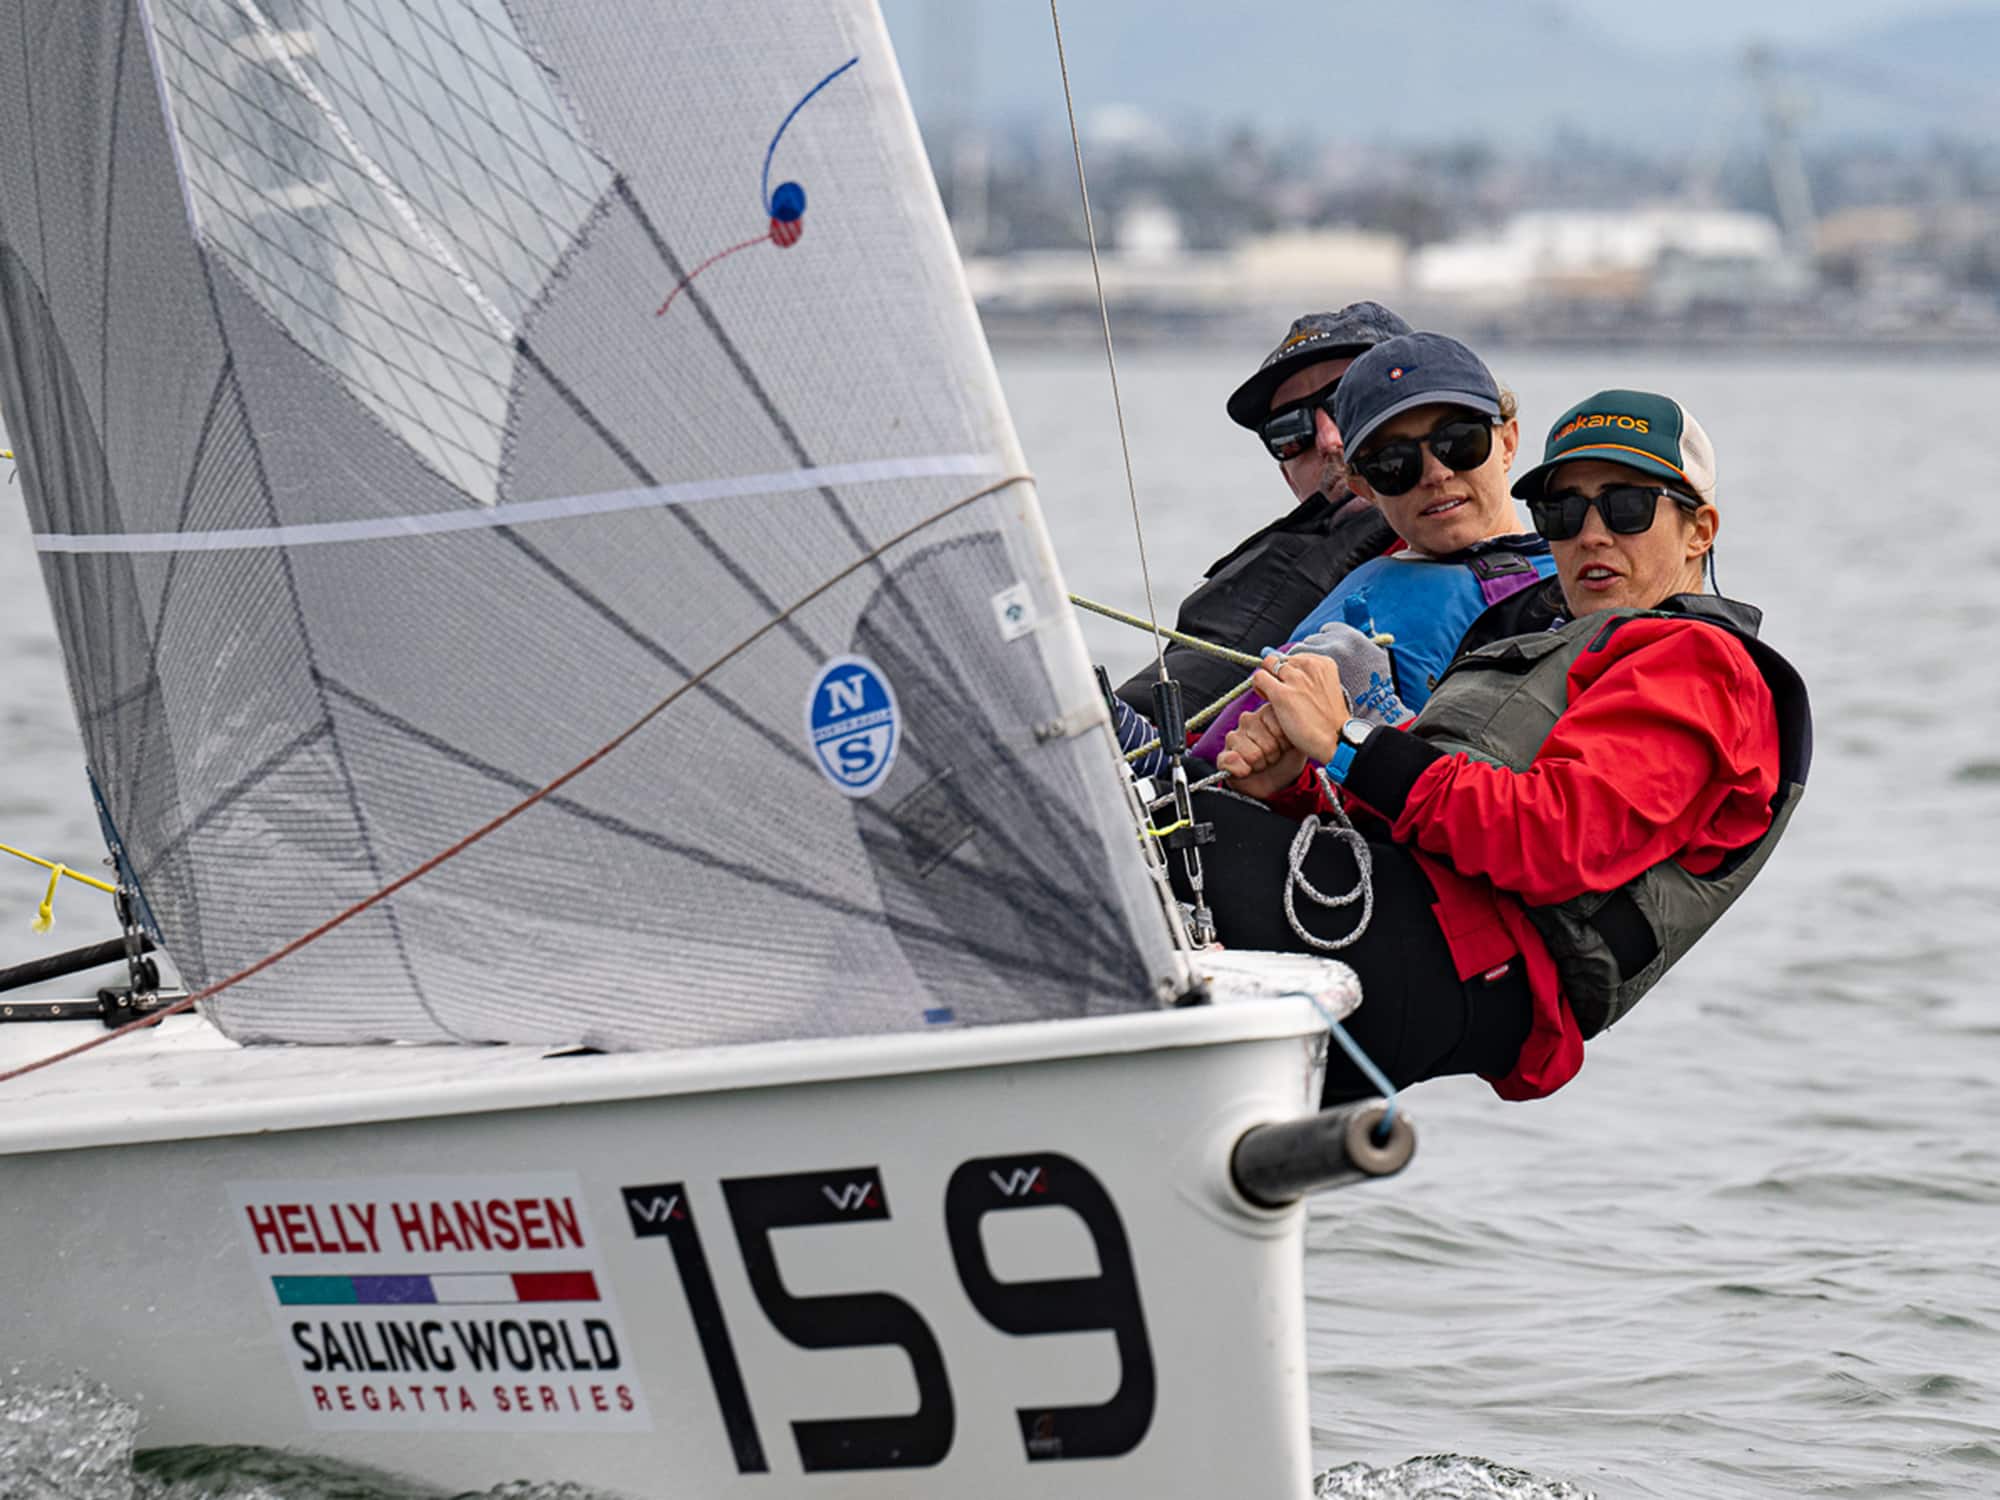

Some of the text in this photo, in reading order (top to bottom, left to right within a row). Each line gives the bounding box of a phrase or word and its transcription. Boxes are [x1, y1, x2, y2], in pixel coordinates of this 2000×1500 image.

[824, 673, 867, 717] N
[838, 735, 875, 774] S
[246, 1197, 585, 1254] HELLY HANSEN
[620, 1151, 1157, 1475] 159
[291, 1319, 621, 1371] SAILING WORLD
[312, 1384, 636, 1412] REGATTA SERIES
